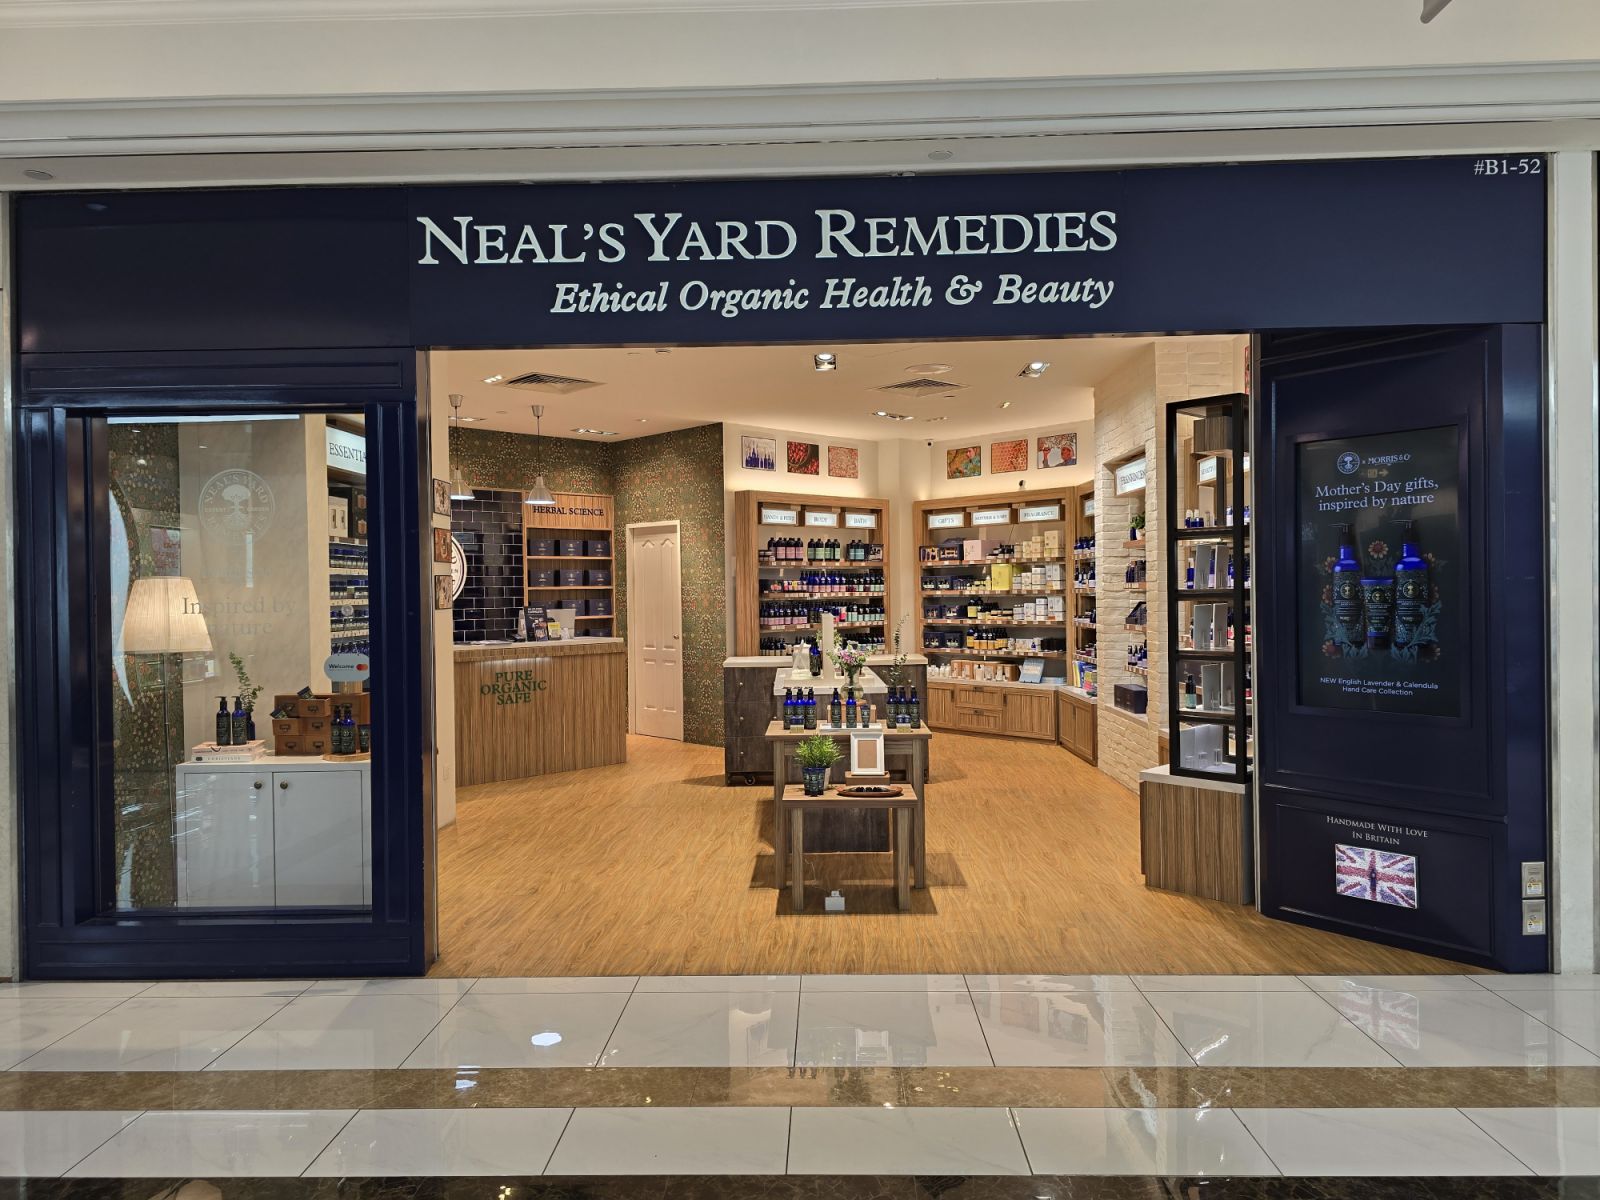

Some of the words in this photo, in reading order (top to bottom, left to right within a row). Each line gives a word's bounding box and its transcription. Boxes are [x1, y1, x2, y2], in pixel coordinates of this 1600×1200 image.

[1474, 158, 1541, 175] #B1-52
[416, 216, 626, 264] NEAL'S
[633, 212, 798, 262] YARD
[814, 209, 1118, 259] REMEDIES
[550, 281, 669, 313] Ethical
[679, 278, 809, 318] Organic
[819, 275, 933, 309] Health
[944, 274, 983, 306] &
[992, 273, 1115, 309] Beauty
[1367, 454, 1398, 465] MORRIS
[1315, 482, 1370, 498] Mother's
[1375, 481, 1401, 494] Day
[1405, 477, 1439, 493] gifts,
[1319, 497, 1368, 512] inspired
[1372, 496, 1387, 508] by
[1391, 494, 1434, 506] nature
[533, 505, 567, 515] HERBAL
[569, 507, 604, 517] SCIENCE
[495, 670, 533, 683] PURE
[1338, 678, 1362, 686] English
[1363, 679, 1394, 687] Lavender
[1403, 681, 1439, 690] Calendula
[480, 680, 547, 696] ORGANIC
[1378, 688, 1414, 696] Collection
[497, 692, 532, 706] SAFE
[1326, 815, 1376, 830] HANDMADE
[1377, 823, 1403, 834] WITH
[1405, 827, 1429, 838] LOVE
[1352, 831, 1363, 839] IN
[1365, 833, 1400, 845] BRITAIN
